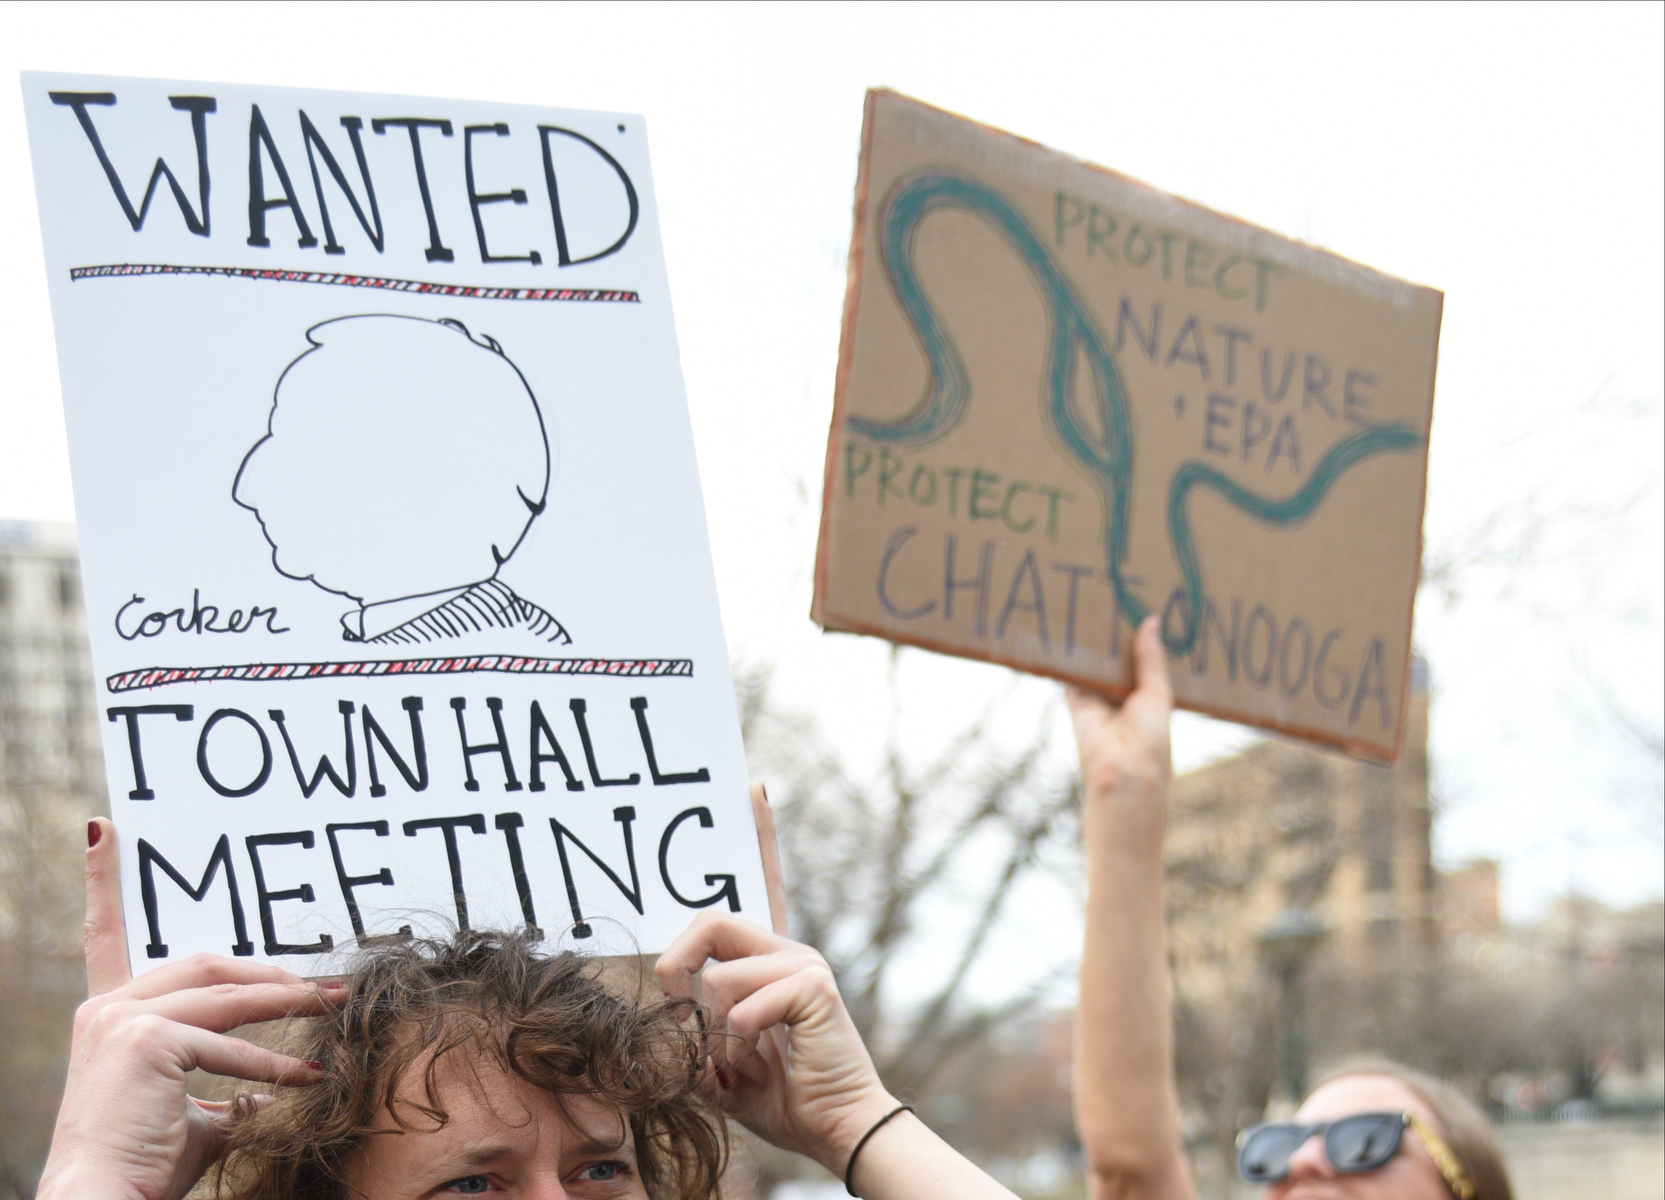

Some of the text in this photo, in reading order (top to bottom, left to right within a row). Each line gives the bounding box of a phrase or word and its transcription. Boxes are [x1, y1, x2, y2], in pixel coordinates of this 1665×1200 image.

[48, 92, 640, 268] WANTED
[1053, 190, 1289, 316] PROTECT
[1112, 296, 1378, 428] NATURE
[845, 441, 1077, 546] PROTECT
[115, 588, 290, 642] Corker
[876, 526, 1393, 729] CHATTANOOGA
[106, 696, 711, 801] TOWN HALL
[137, 806, 742, 959] MEETING
